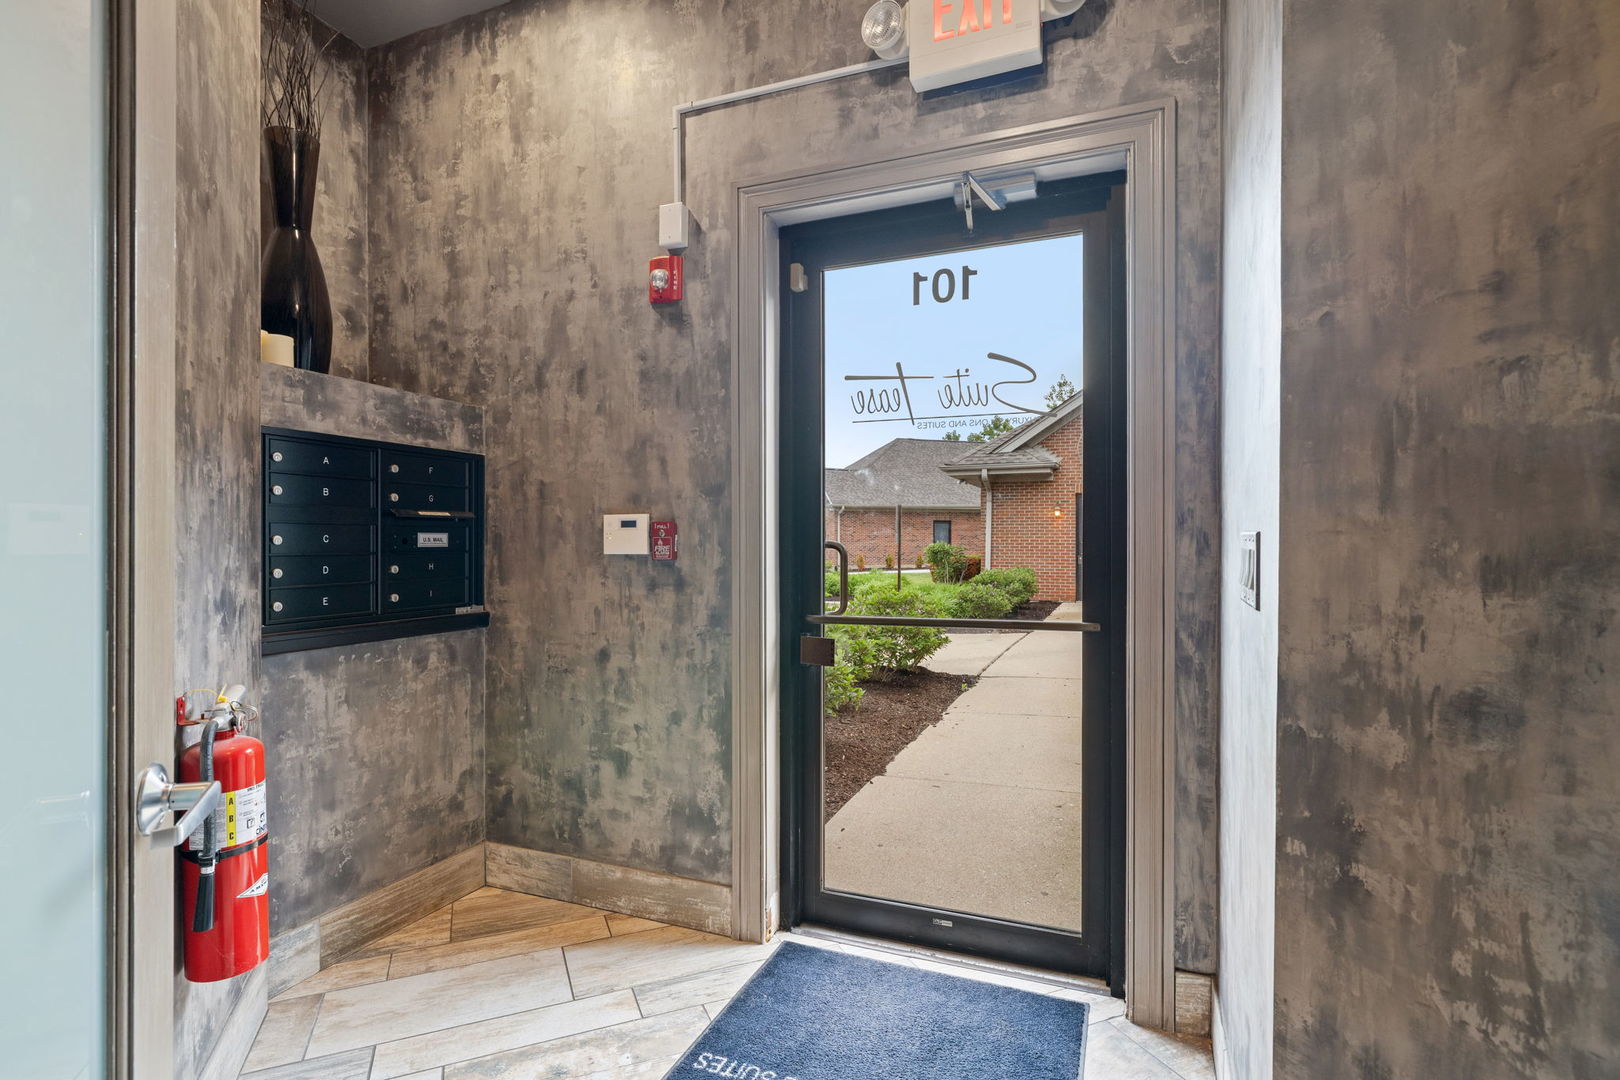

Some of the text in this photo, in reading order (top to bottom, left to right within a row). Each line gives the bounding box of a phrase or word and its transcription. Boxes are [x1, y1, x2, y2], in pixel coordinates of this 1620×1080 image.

[322, 456, 330, 465] A
[428, 466, 434, 475] F
[322, 487, 329, 496] B
[428, 494, 434, 502] G
[322, 534, 329, 543] C
[322, 565, 329, 574] D
[322, 597, 329, 606] E
